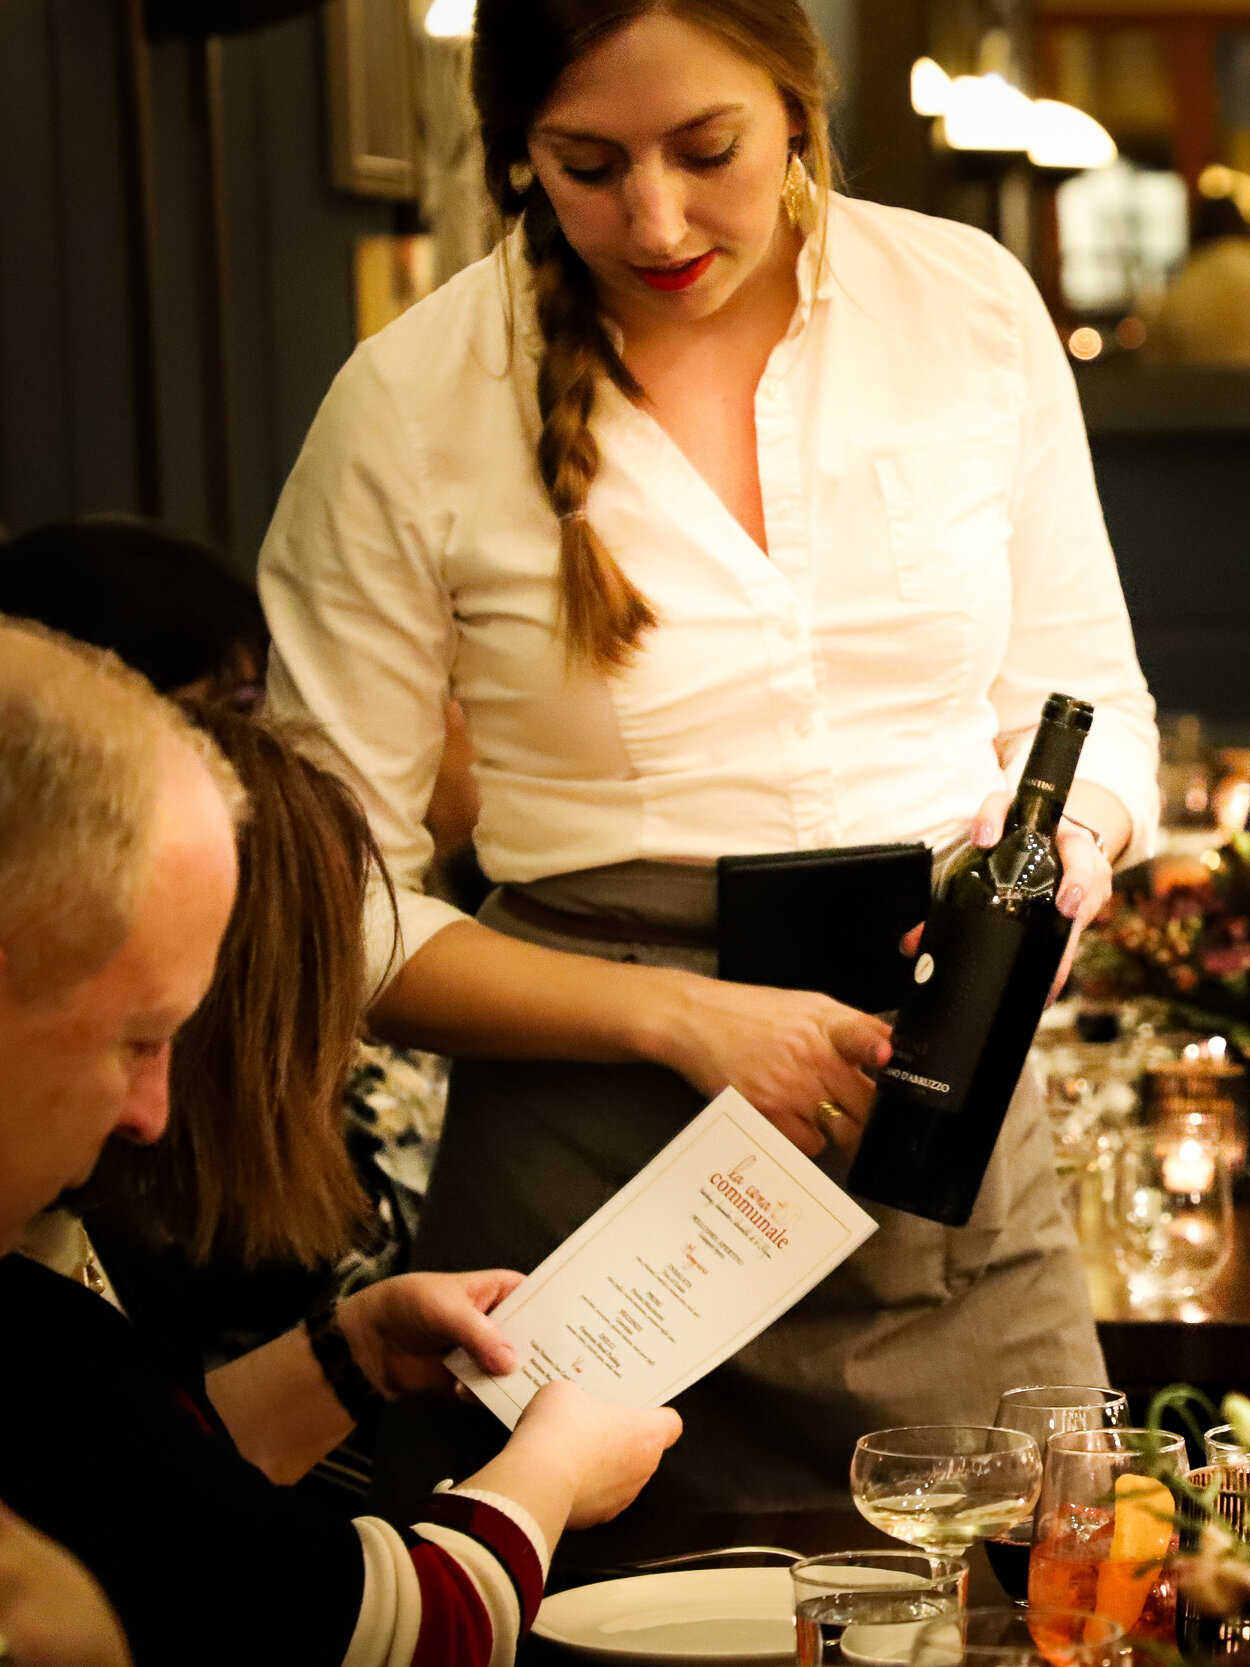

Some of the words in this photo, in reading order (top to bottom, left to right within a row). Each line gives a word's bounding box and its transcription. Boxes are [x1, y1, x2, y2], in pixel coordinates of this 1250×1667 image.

[709, 1172, 789, 1249] communale
[727, 1155, 757, 1185] la
[745, 1185, 772, 1211] cena
